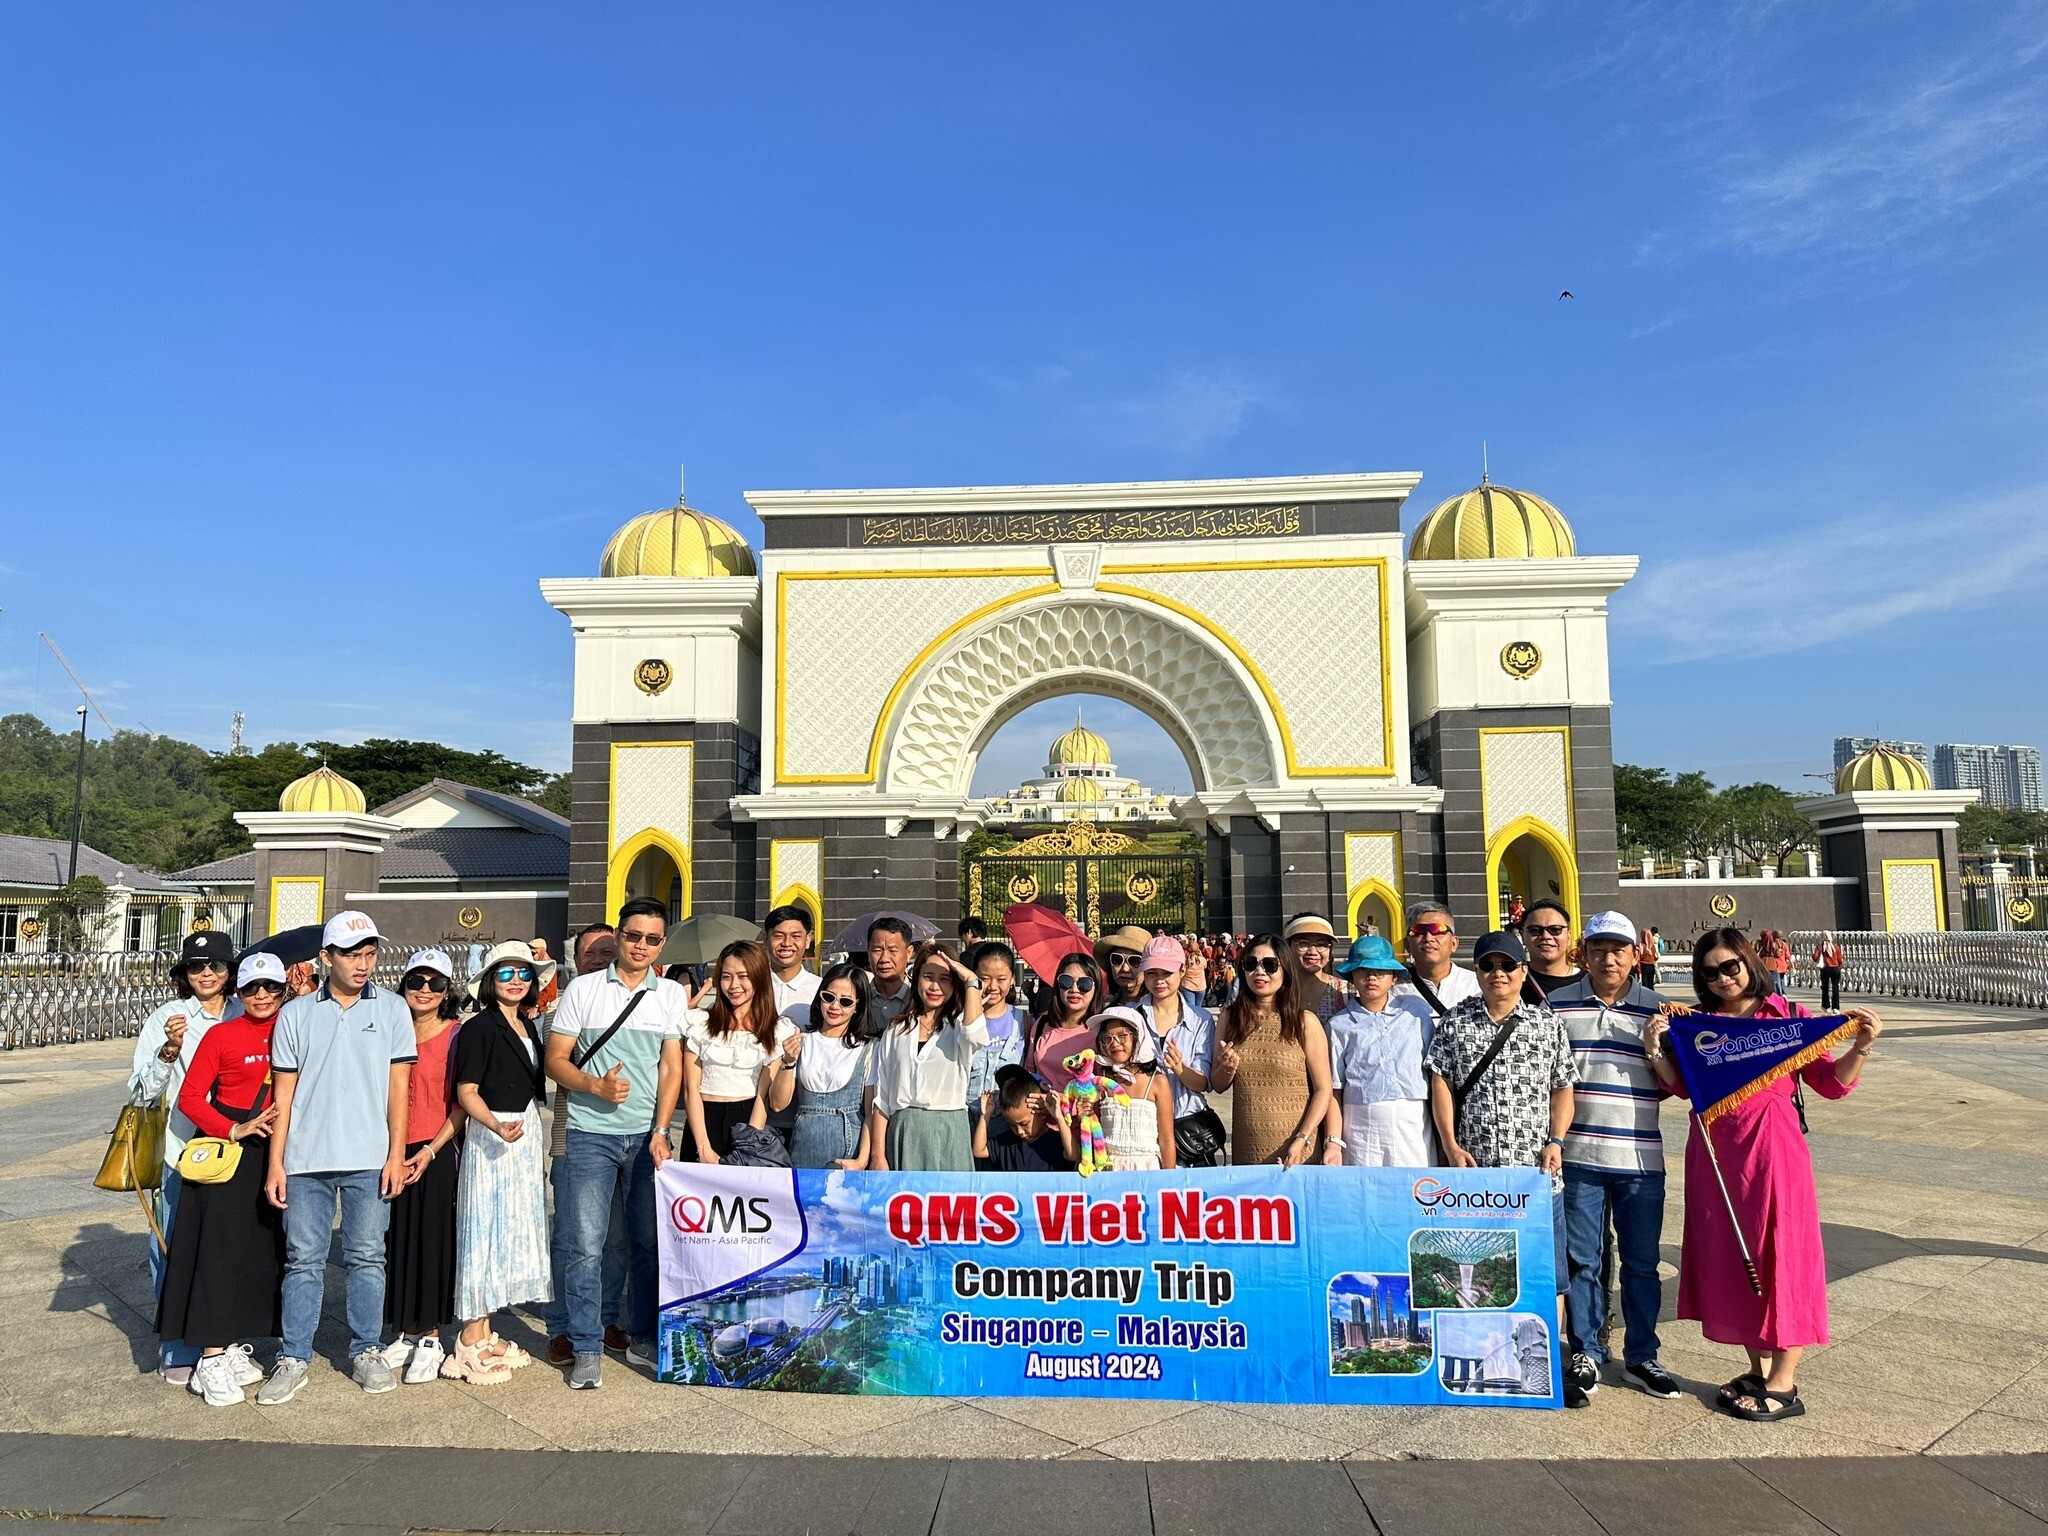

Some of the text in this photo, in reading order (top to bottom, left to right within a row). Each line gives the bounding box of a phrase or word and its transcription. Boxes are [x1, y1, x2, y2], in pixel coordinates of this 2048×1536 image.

[671, 1195, 772, 1233] QMS
[888, 1191, 1292, 1246] QMS Viet Nam
[672, 1234, 687, 1243] Viet
[690, 1236, 710, 1244] Nam
[718, 1236, 738, 1245] Asia
[741, 1236, 772, 1245] Pacific
[955, 1262, 1232, 1306] Company Trip
[943, 1313, 1082, 1347] Singapore
[1118, 1316, 1246, 1350] Malaysia
[1026, 1353, 1160, 1380] August 2024
